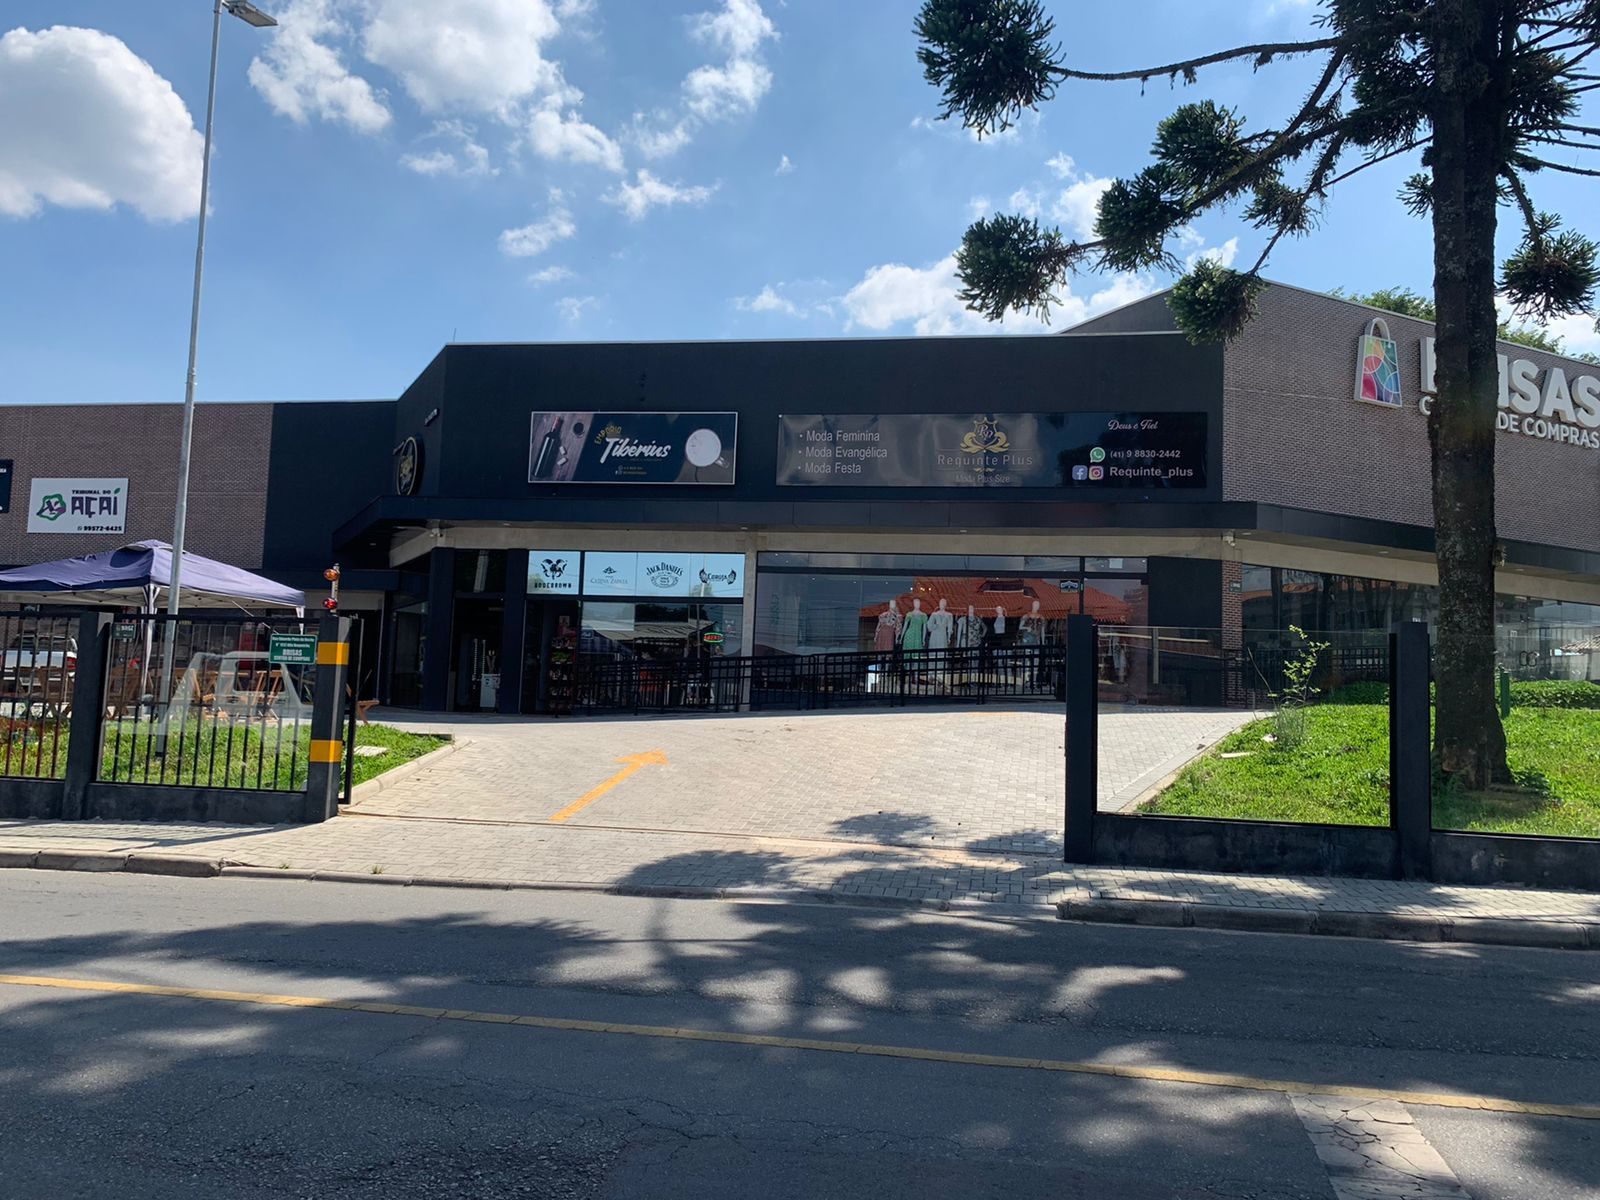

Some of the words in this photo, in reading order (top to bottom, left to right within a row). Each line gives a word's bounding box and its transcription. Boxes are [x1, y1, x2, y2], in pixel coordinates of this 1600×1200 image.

[1420, 337, 1600, 429] ISAS
[1108, 420, 1132, 430] Deus
[1497, 411, 1520, 432] DE
[1523, 417, 1599, 449] COMPRAS
[806, 430, 833, 441] Moda
[836, 430, 880, 441] Feminina
[600, 438, 672, 464] Tibérius
[805, 446, 832, 457] Moda
[835, 446, 887, 460] Evangélica
[1110, 450, 1124, 459] (41)
[1126, 450, 1132, 459] 9
[1134, 450, 1181, 459] 8830-2442
[805, 462, 831, 473] Moda
[834, 462, 862, 473] Festa
[937, 454, 998, 468] Requinte
[1003, 454, 1033, 465] Plus
[994, 474, 1010, 484] Size
[1109, 466, 1194, 479] Requinte_plus
[71, 488, 120, 518] AÇAÍ
[646, 563, 661, 577] JACK
